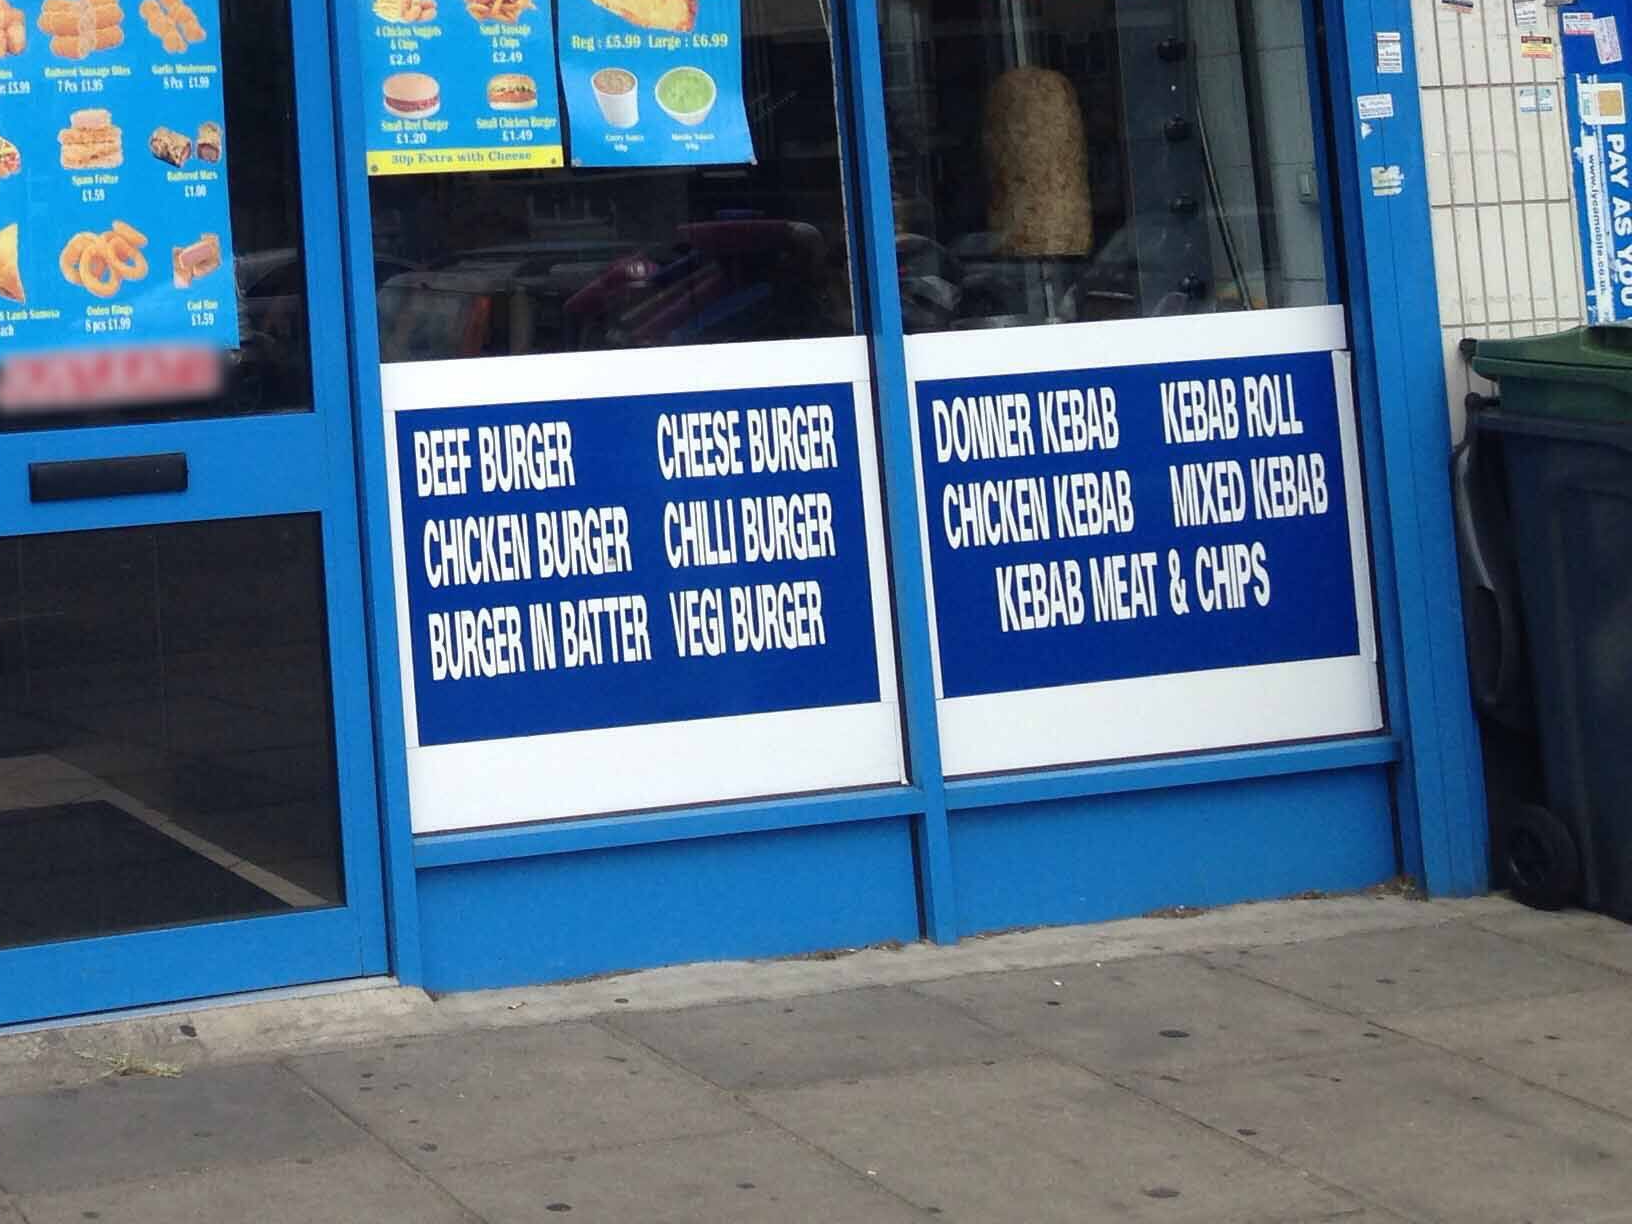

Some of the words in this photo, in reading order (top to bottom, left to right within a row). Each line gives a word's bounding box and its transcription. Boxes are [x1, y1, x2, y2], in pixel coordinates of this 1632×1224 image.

[1607, 134, 1628, 188] PAY
[1613, 197, 1632, 236] AS
[414, 428, 471, 497] BEEF
[478, 421, 576, 493] BURGER
[657, 409, 744, 480] CHEESE
[746, 404, 838, 473] BURGER
[932, 393, 1035, 463] DONNER
[1038, 386, 1119, 453] KEBAB
[1160, 377, 1239, 444] KEBAB
[1245, 374, 1304, 437] ROLL
[423, 514, 531, 587] CHICKEN
[537, 506, 632, 578] BURGER
[664, 497, 737, 568] CHILLI
[742, 492, 836, 563] BURGER
[942, 477, 1050, 549] CHICKEN
[1052, 470, 1134, 538] KEBAB
[1169, 459, 1246, 527] MIXED
[1250, 452, 1328, 520] KEBAB
[428, 606, 526, 681] BURGER
[529, 603, 556, 670] IN
[560, 594, 651, 667] BATTER
[670, 588, 726, 658] VEGI
[731, 580, 826, 652] BURGER
[995, 559, 1085, 633] KEBAB
[1089, 552, 1157, 623] MEAT
[1169, 549, 1190, 615] &
[1195, 541, 1270, 615] CHIPS
